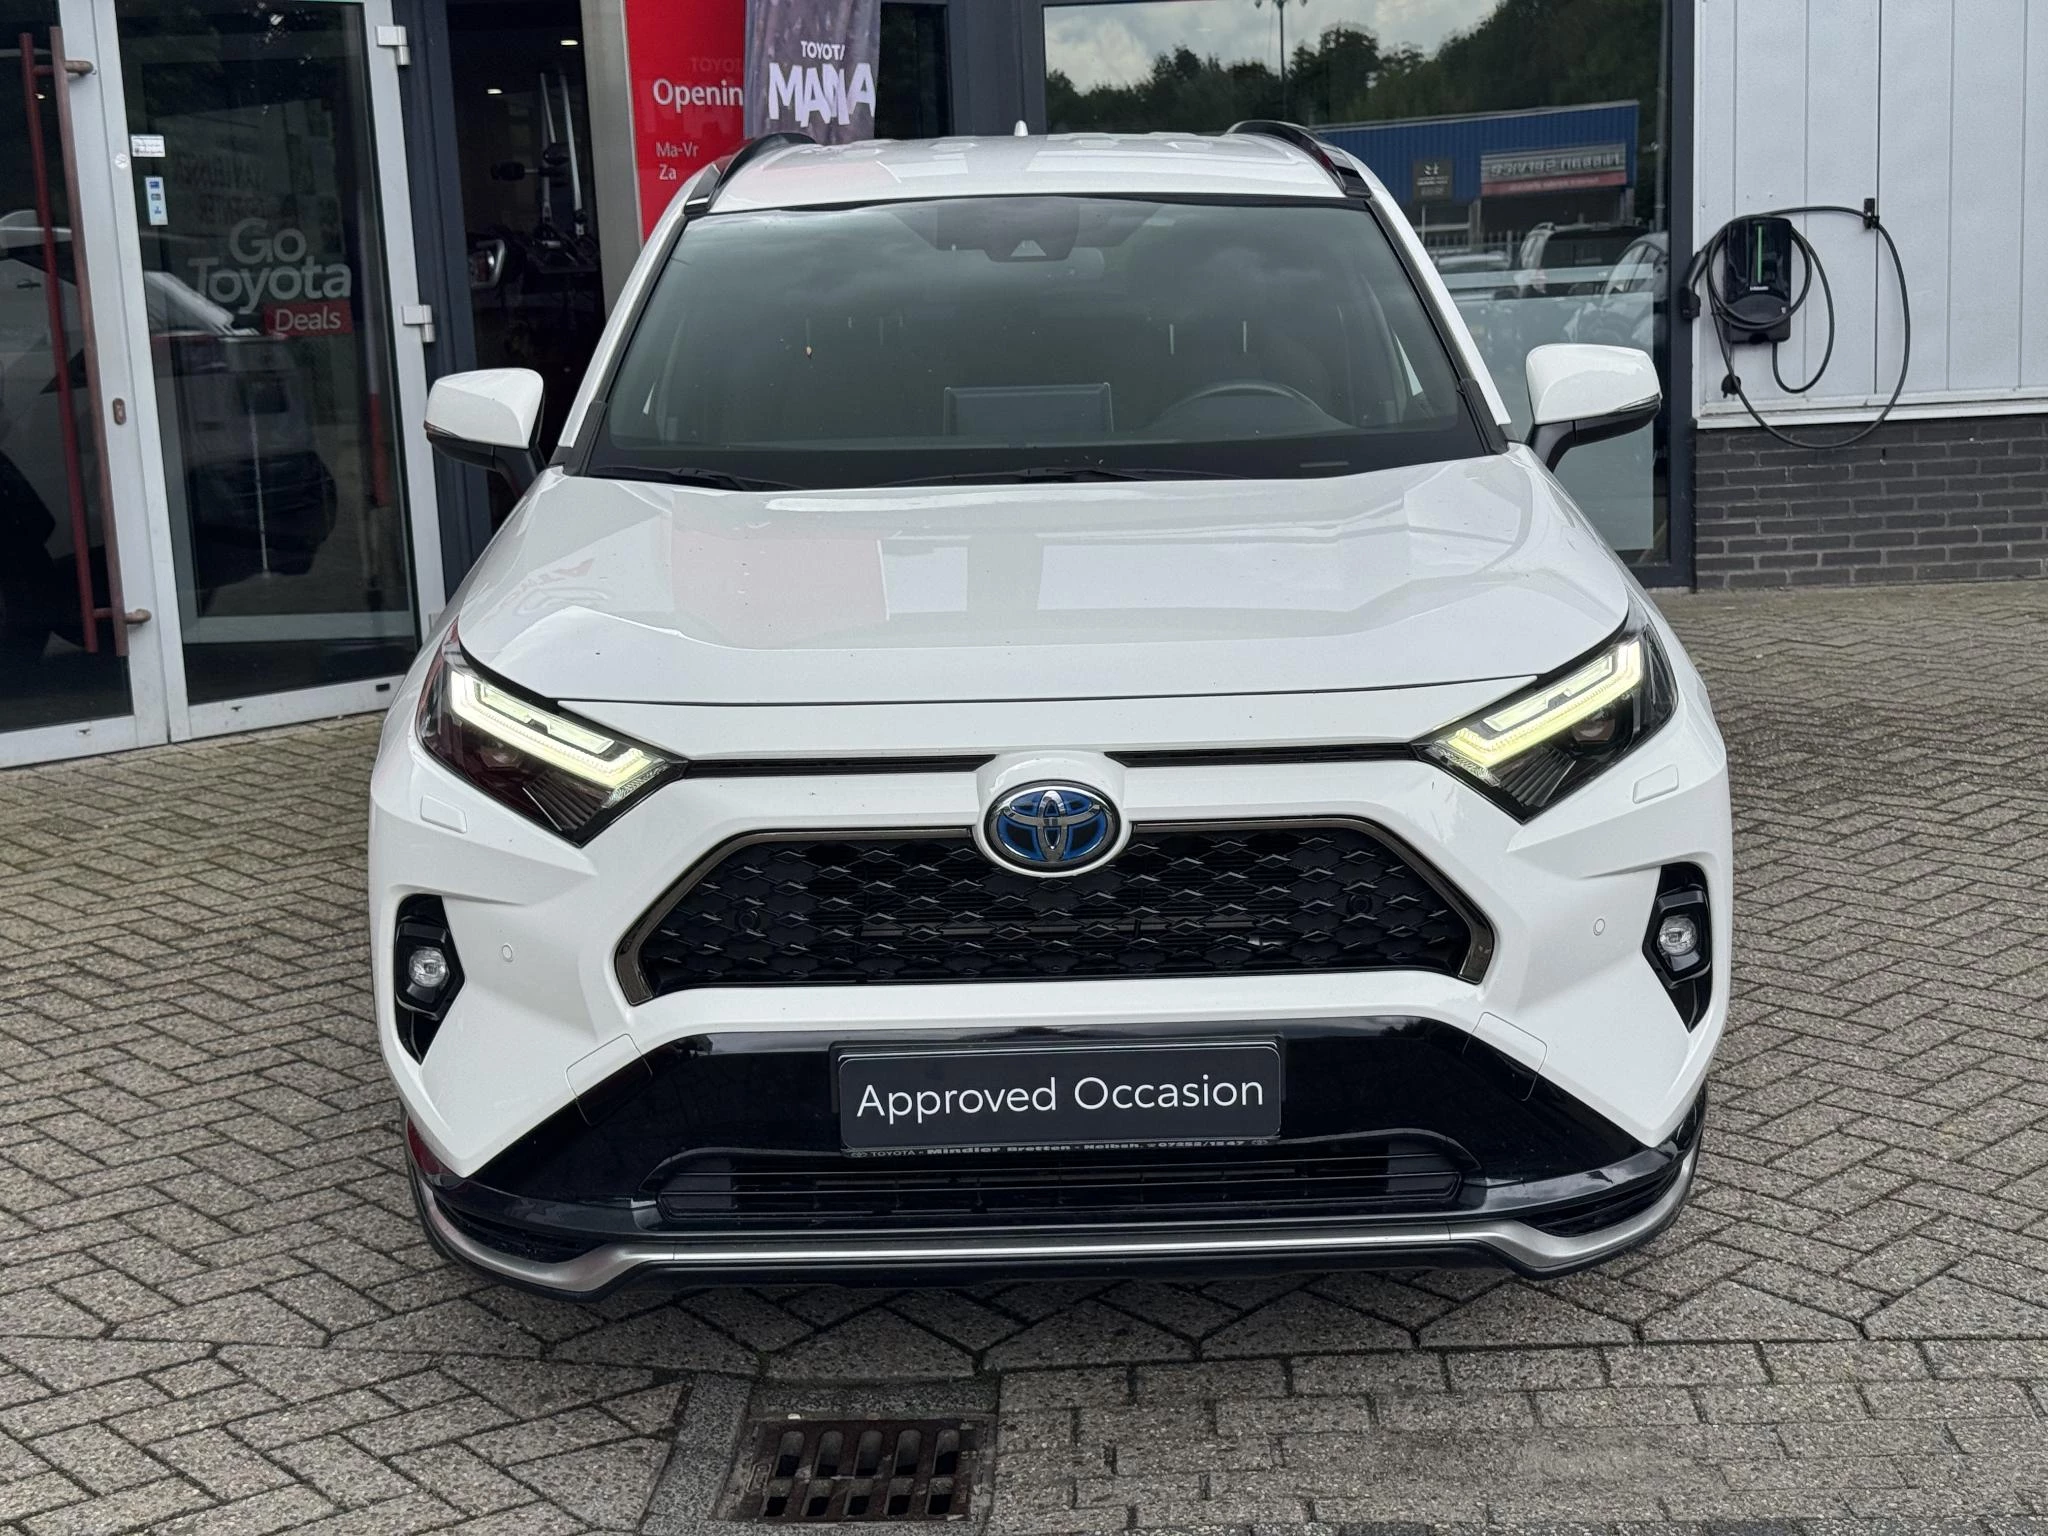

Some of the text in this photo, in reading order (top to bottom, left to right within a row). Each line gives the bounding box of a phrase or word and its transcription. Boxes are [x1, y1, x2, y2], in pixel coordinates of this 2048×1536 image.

[656, 141, 699, 159] Ma-Vr
[659, 165, 678, 181] Za
[229, 217, 307, 265] Go
[188, 256, 352, 315] Toyota
[274, 304, 342, 332] Deals
[856, 1074, 1264, 1124] Approved Occasion
